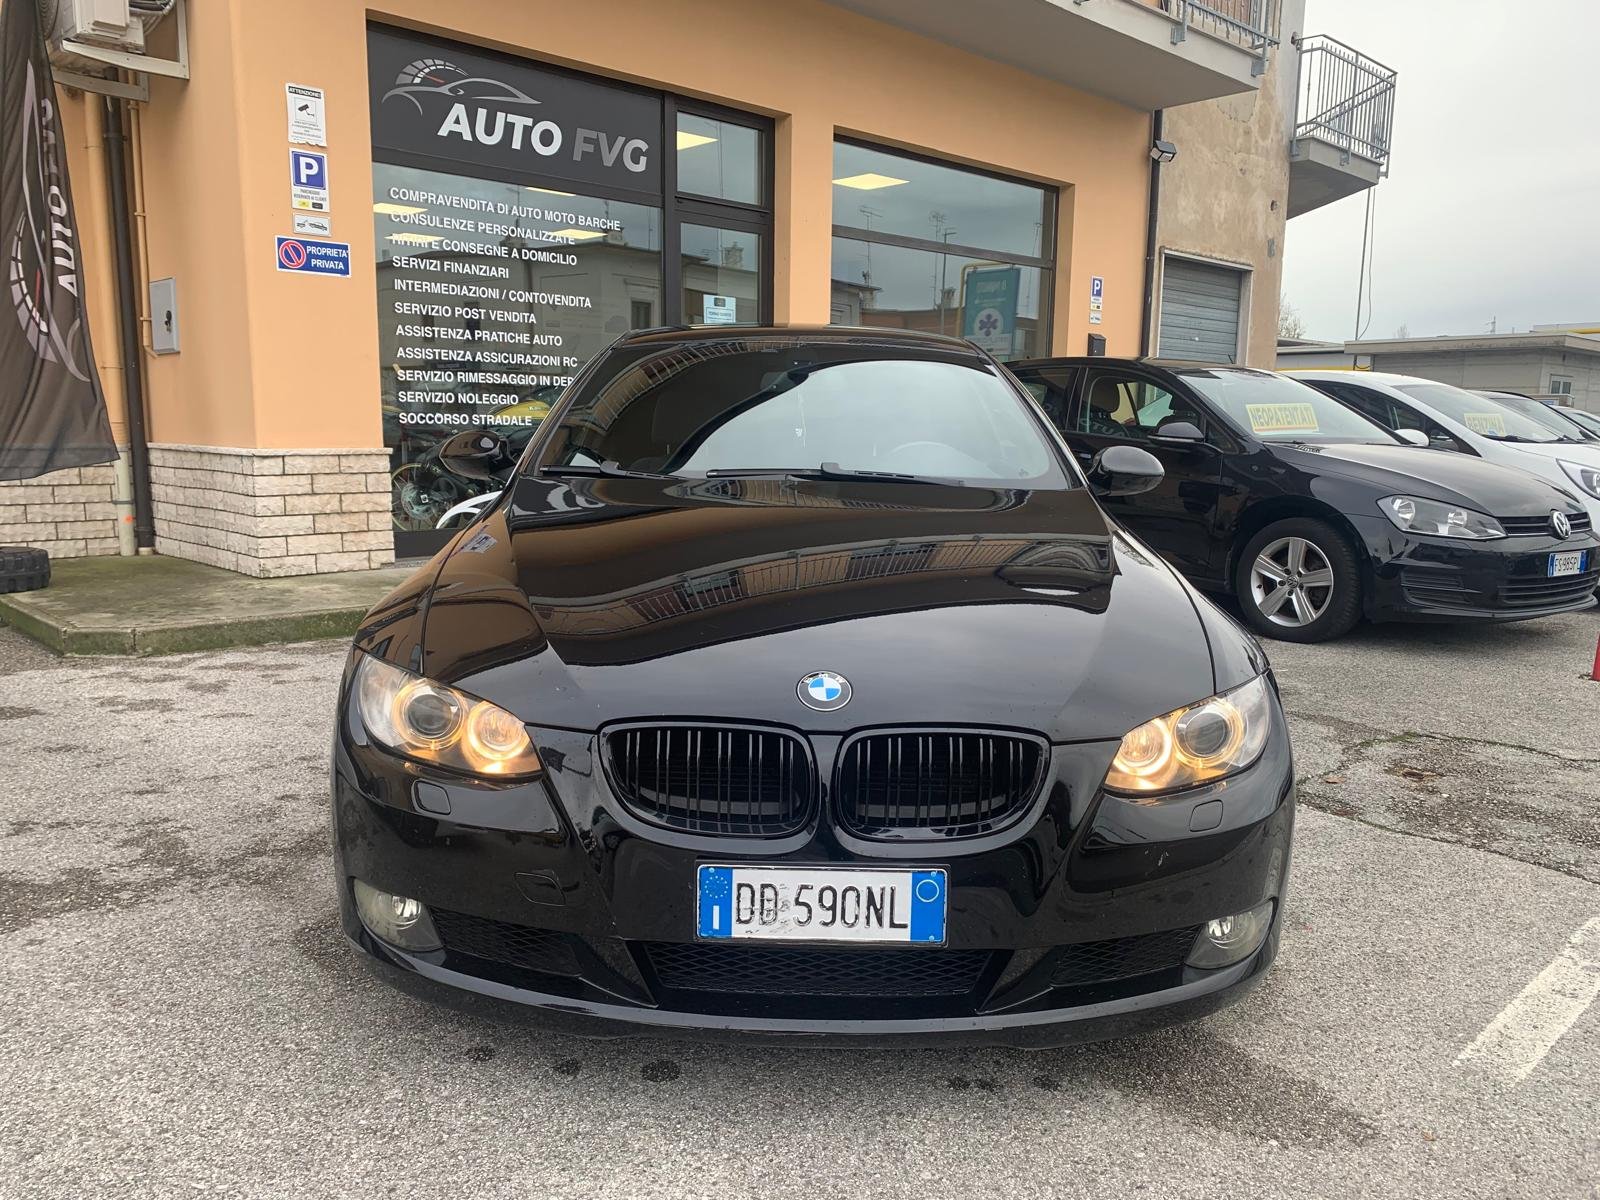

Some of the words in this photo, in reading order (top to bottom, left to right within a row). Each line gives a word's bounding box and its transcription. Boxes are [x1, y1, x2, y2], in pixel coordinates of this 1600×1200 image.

[437, 103, 562, 156] AUTO
[572, 128, 649, 172] FVG
[300, 156, 319, 183] P
[390, 187, 494, 213] COMPRAVENDITA
[497, 203, 509, 215] DI
[512, 205, 541, 220] AUTO
[544, 210, 576, 225] MOTO
[578, 214, 621, 231] BARCHE
[391, 212, 475, 233] CONSULENZE
[478, 222, 576, 245] PERSONALIZZATE
[48, 185, 77, 297] AUTO
[442, 239, 508, 258] CONSEGNE
[511, 247, 520, 259] A
[521, 249, 577, 266] DOMICILIO
[311, 259, 344, 270] PRIVATA
[392, 255, 441, 272] SERVIZI
[443, 261, 509, 279] FINANZIARI
[394, 278, 500, 299] INTERMEDIAZIONI
[509, 290, 592, 308] CONTOVENDITA
[1093, 280, 1101, 294] P
[394, 302, 451, 317] SERVIZIO
[454, 307, 486, 320] POST
[489, 310, 536, 324] VENDITA
[395, 325, 472, 340] ASSISTENZA
[474, 330, 531, 344] PRATICHE
[533, 335, 563, 347] AUTO
[397, 347, 472, 361] ASSISTENZA
[475, 352, 560, 366] ASSICURAZIONI
[562, 356, 578, 367] RC
[397, 369, 454, 382] SERVIZIO
[457, 372, 537, 386] RIMESSAGGIO
[539, 375, 550, 386] IN
[398, 391, 454, 404] SERVIZIO
[458, 392, 519, 405] NOLEGGIO
[399, 413, 469, 425] SOCCORSO
[472, 414, 532, 426] STRADALE
[793, 884, 909, 929] 590NL
